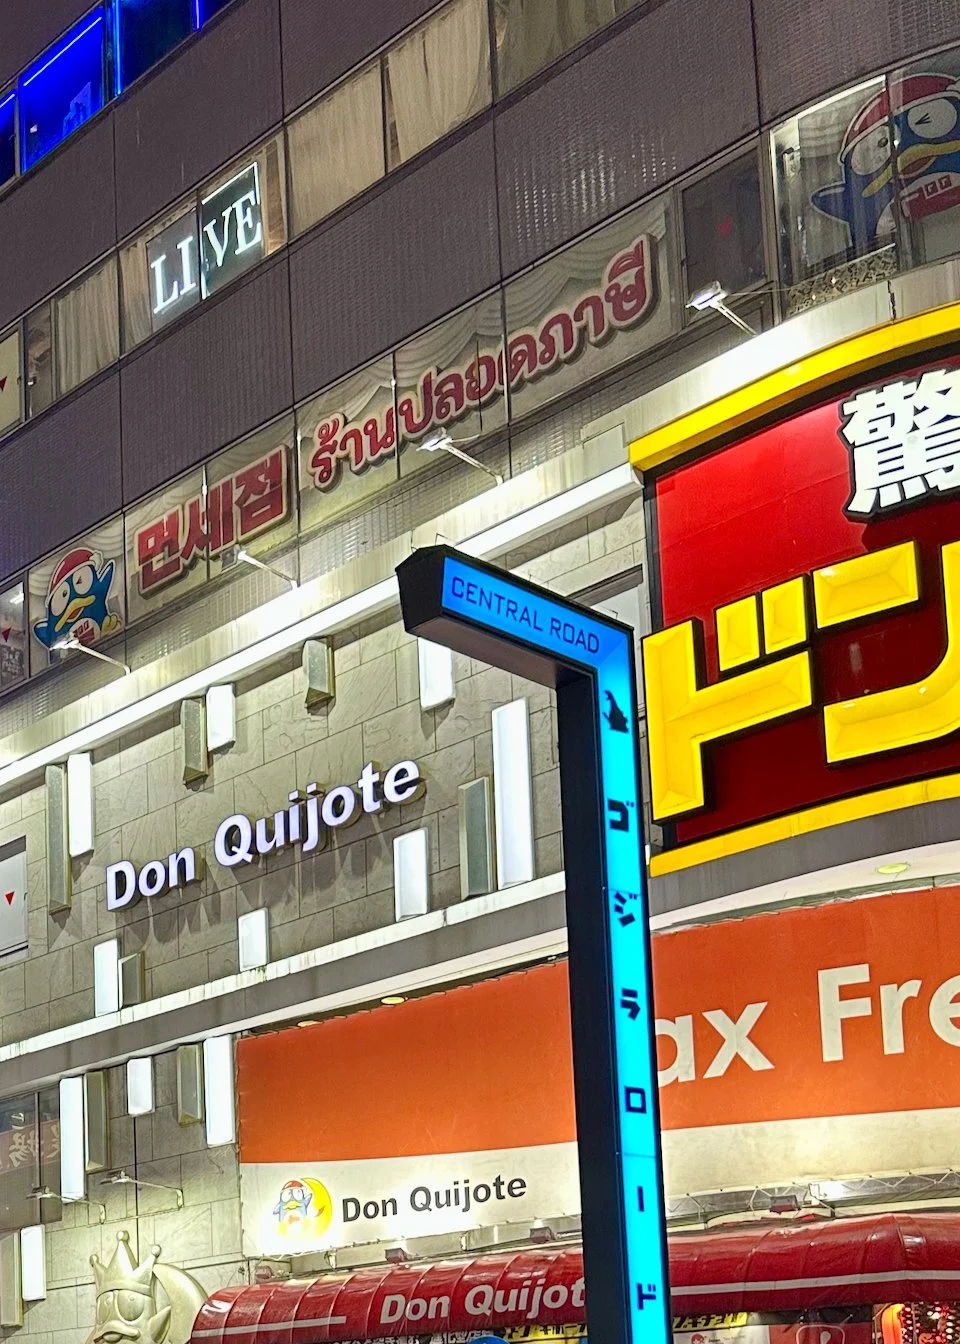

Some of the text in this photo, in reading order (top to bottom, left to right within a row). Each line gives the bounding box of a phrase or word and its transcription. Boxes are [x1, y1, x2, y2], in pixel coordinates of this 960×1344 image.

[150, 190, 262, 315] LIVE
[137, 449, 284, 591] 면세점
[451, 576, 600, 654] CENTRAL ROAD
[105, 759, 422, 911] Don Quijote
[607, 798, 657, 1311] ゴジラロード
[655, 1001, 775, 1088] ax
[342, 1174, 527, 1223] Don Quijote
[380, 1276, 587, 1324] Don Quijot
